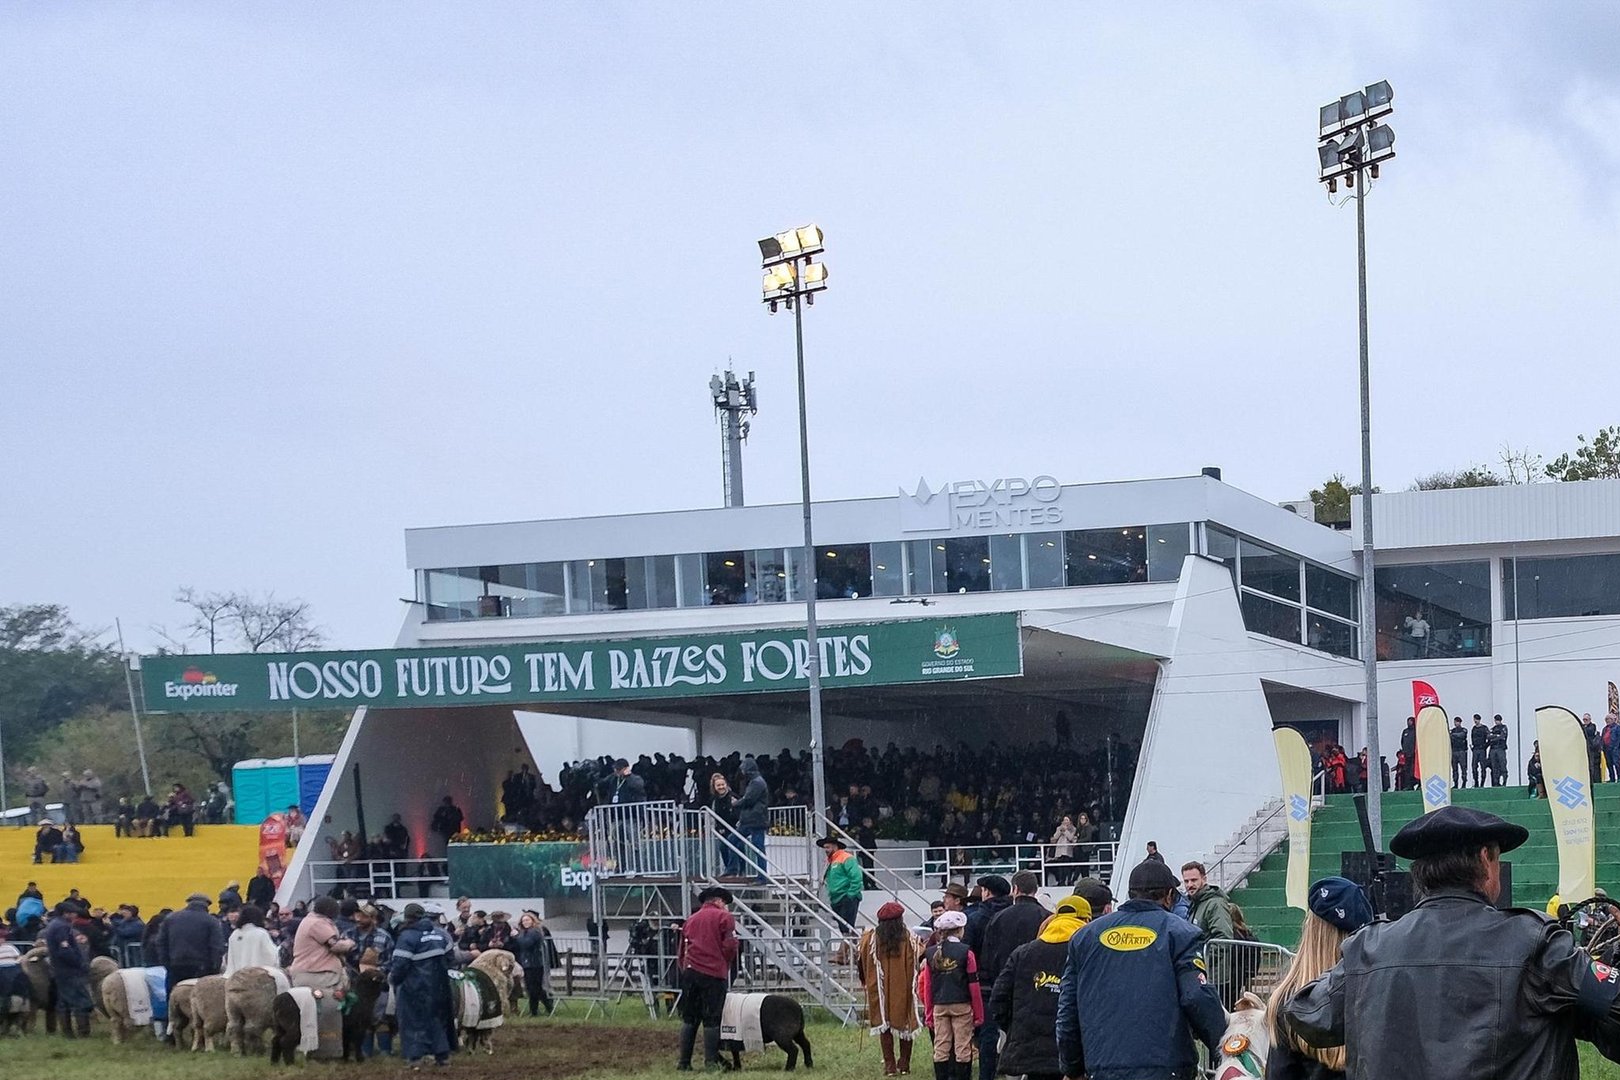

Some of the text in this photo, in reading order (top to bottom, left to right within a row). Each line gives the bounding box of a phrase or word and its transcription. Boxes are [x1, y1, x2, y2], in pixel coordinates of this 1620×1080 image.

[953, 475, 1063, 509] EXPO
[955, 506, 1064, 530] MENTES
[267, 660, 383, 700] NOSSO
[395, 654, 512, 697] FUTURO
[524, 650, 595, 693] TEM
[740, 634, 872, 683] FORTES
[165, 681, 239, 701] Expointer
